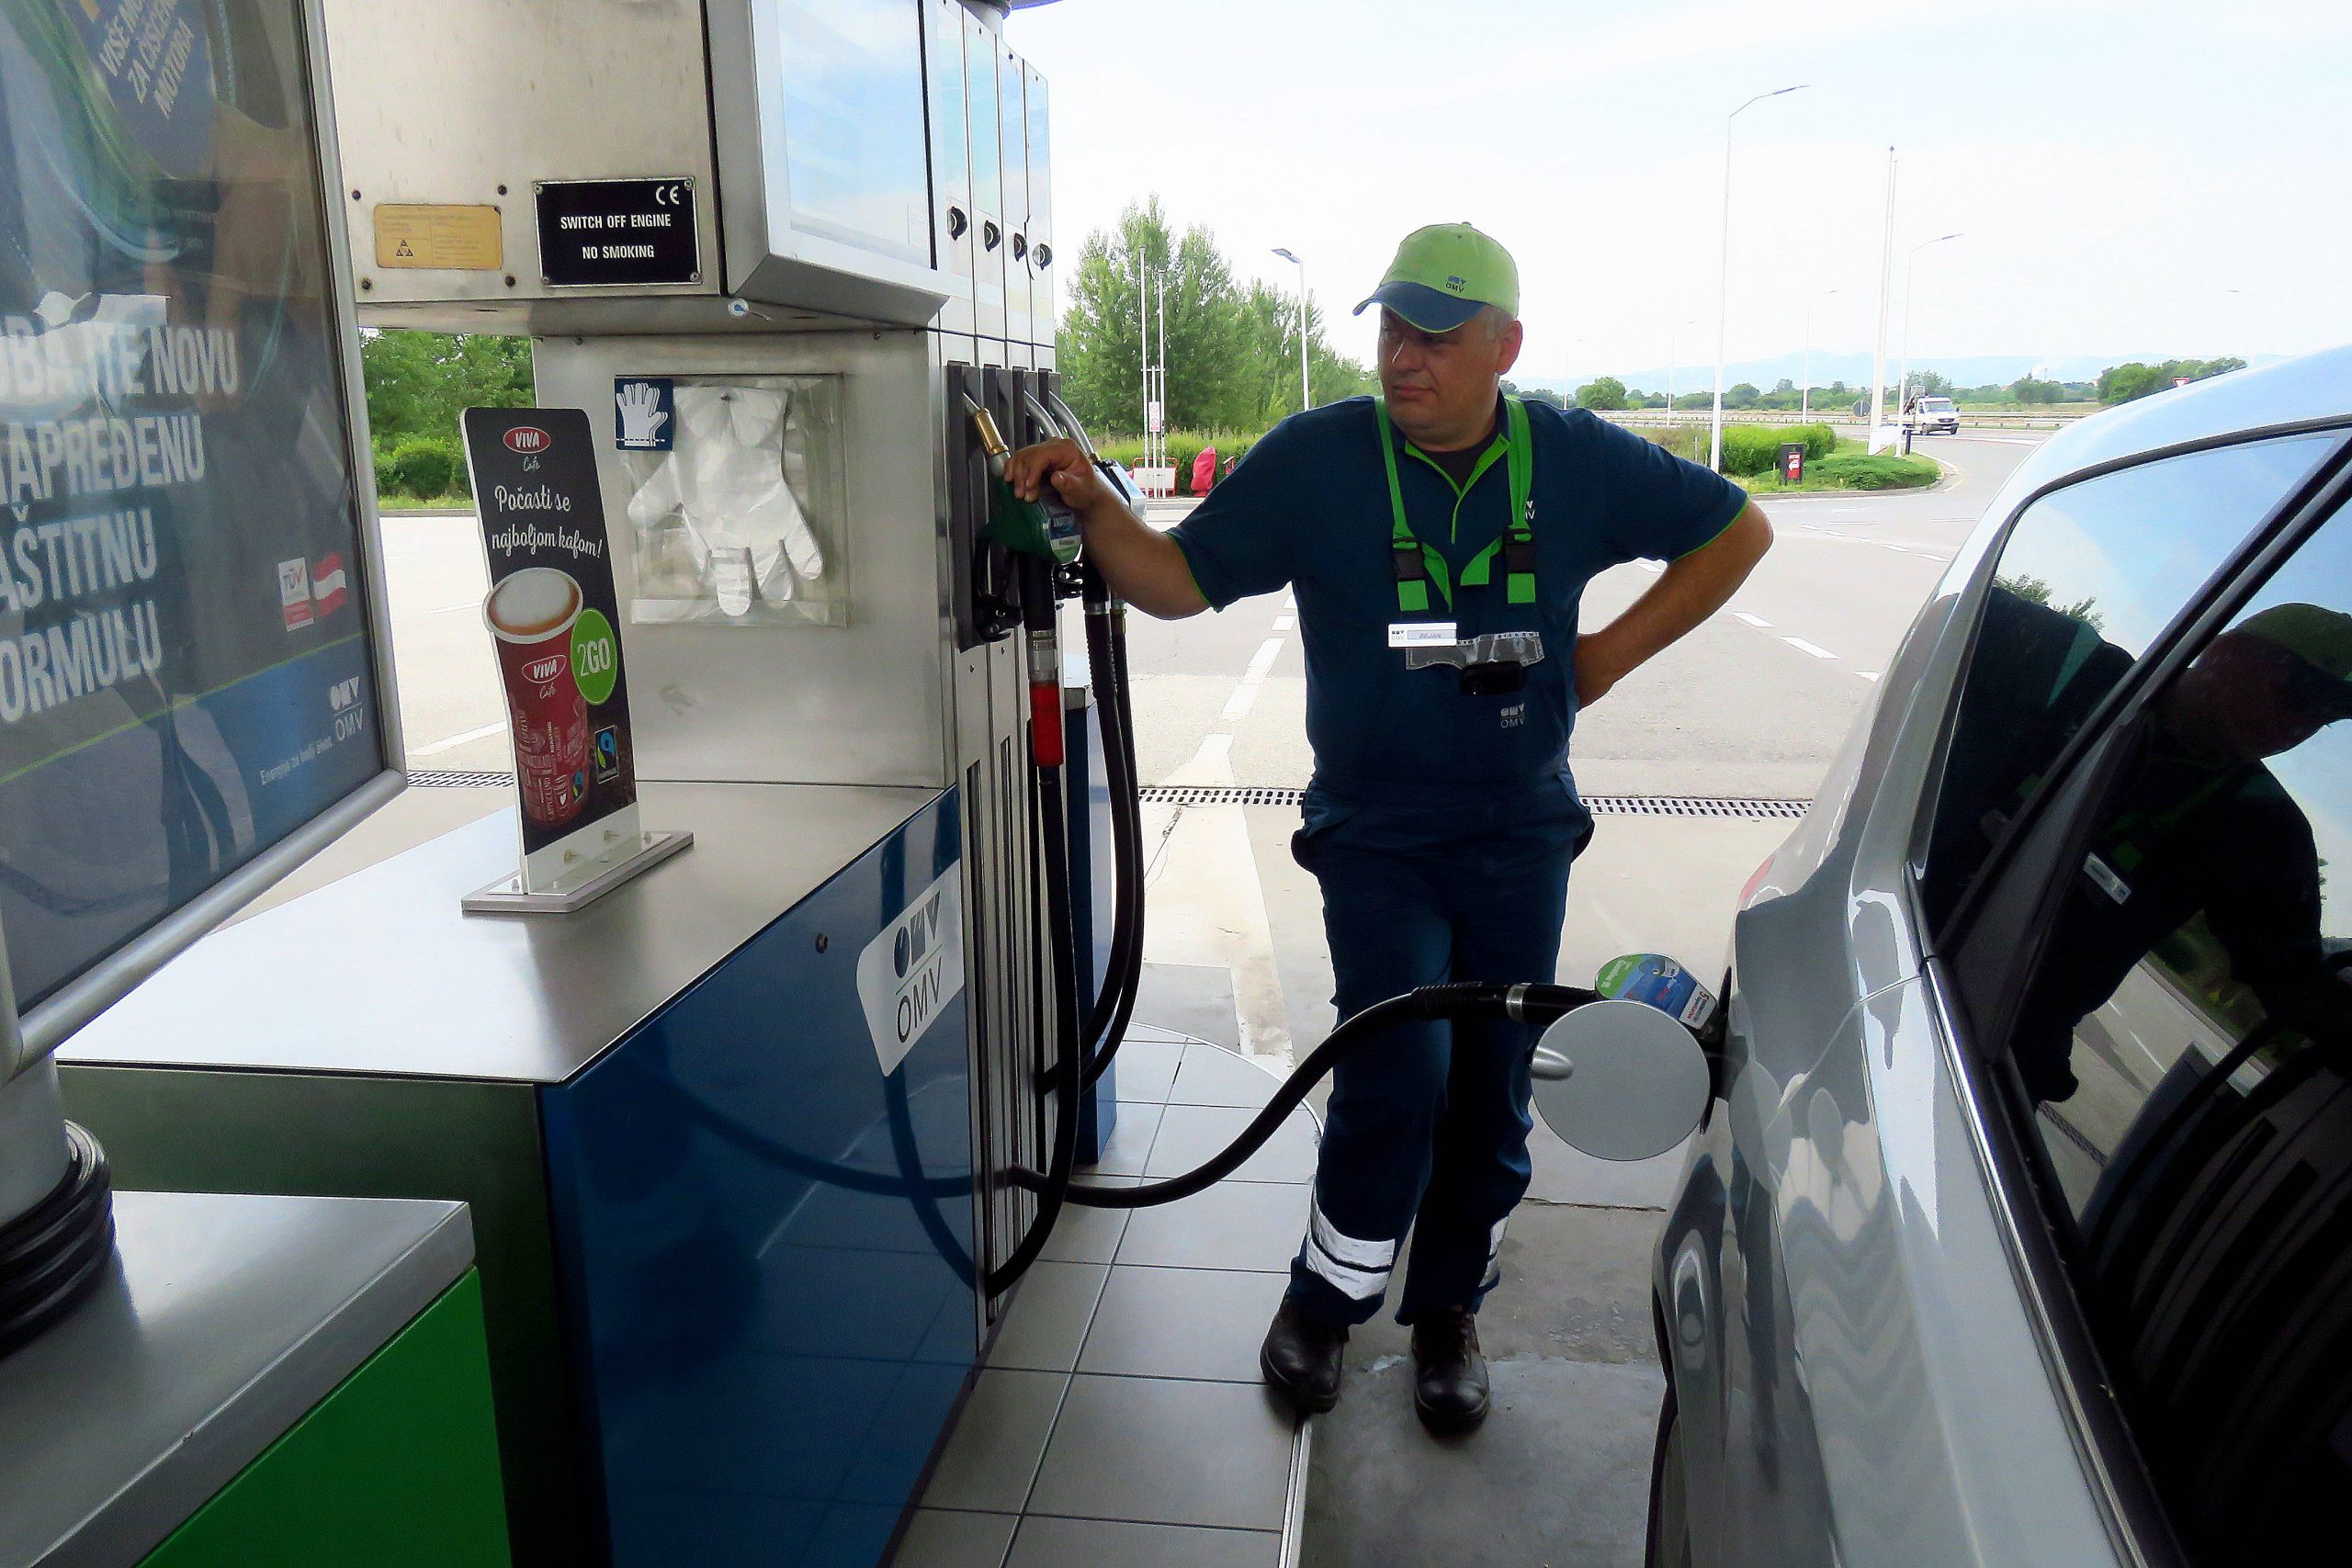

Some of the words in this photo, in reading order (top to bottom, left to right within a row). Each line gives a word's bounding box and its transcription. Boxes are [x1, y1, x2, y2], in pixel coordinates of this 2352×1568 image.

[560, 215, 603, 230] SWITCH
[606, 214, 627, 228] OFF
[630, 213, 672, 228] ENGINE
[582, 246, 598, 259] NO
[602, 244, 655, 258] SMOKING
[1445, 282, 1464, 293] OMV
[150, 324, 238, 396] NOVU
[514, 432, 540, 449] VIVA
[0, 414, 206, 504] APREĐENU
[494, 484, 551, 513] Počasti
[555, 496, 571, 513] se
[492, 523, 557, 558] najboljom
[558, 525, 603, 559] kafom!
[0, 600, 162, 723] ORMULU
[533, 659, 558, 679] VIVA
[577, 637, 612, 677] 2GO
[335, 707, 363, 741] OMV
[1500, 716, 1525, 728] OMV
[896, 955, 943, 1043] OMV
